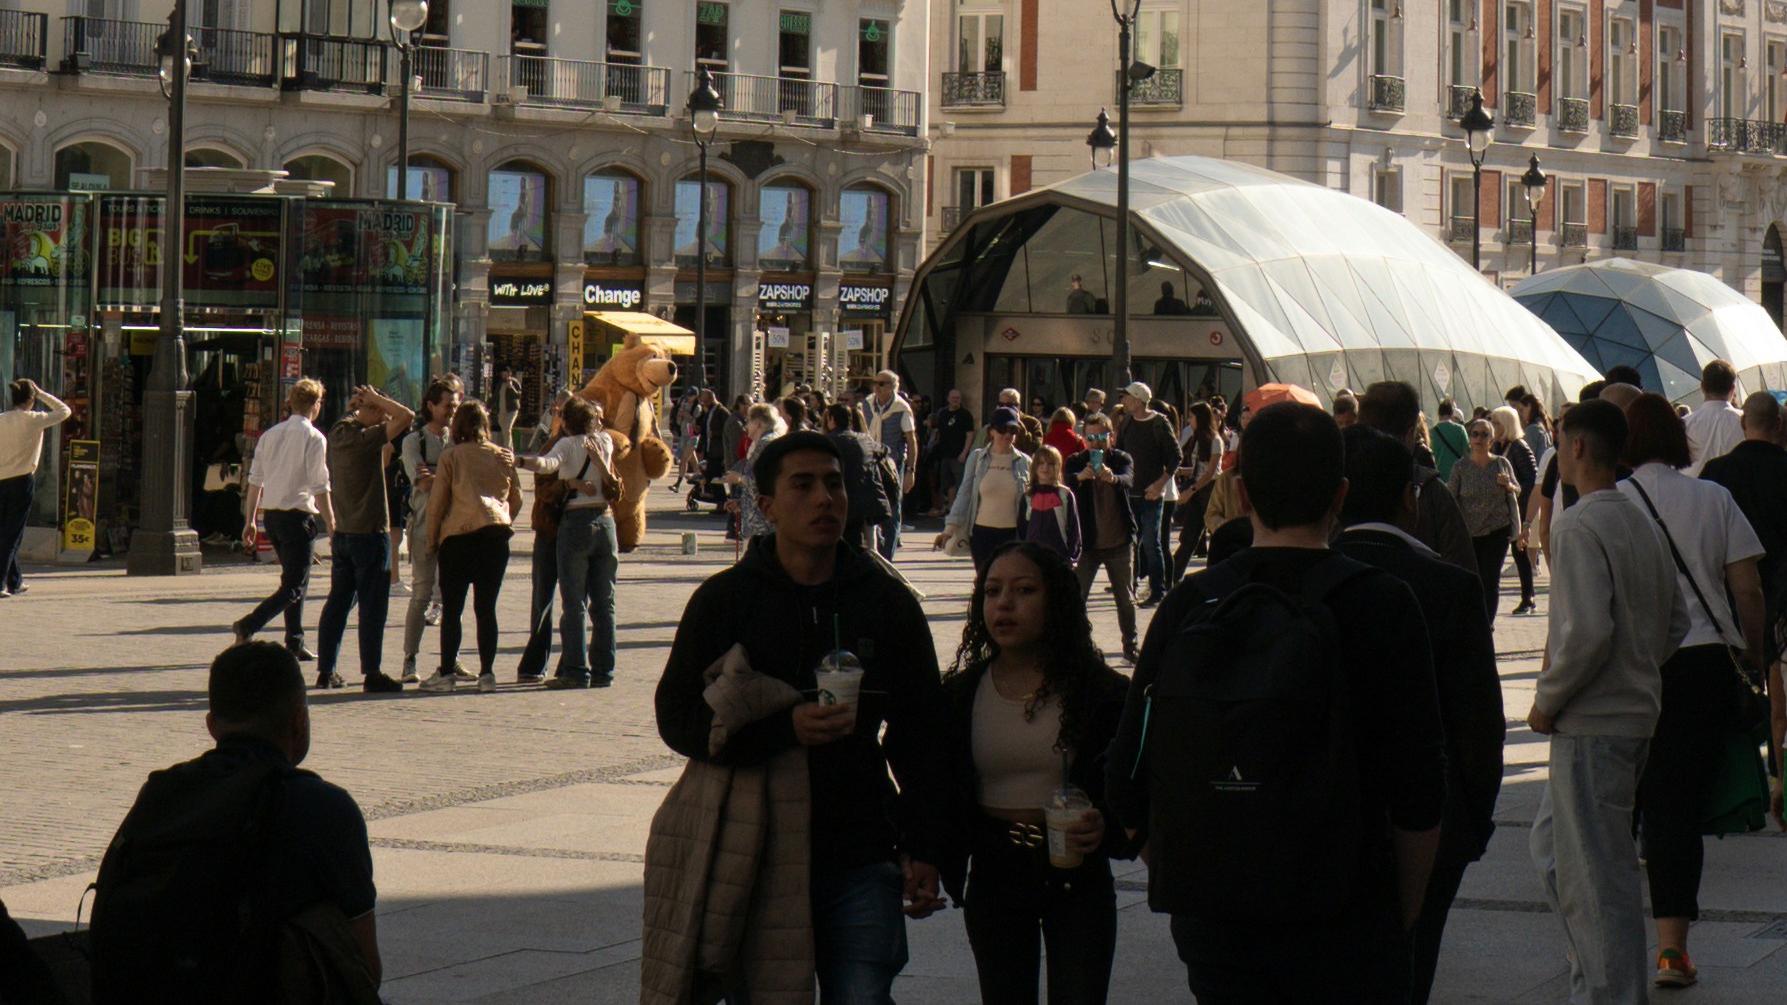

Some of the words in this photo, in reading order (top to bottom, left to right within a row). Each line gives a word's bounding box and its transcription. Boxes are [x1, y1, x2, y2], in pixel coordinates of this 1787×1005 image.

[3, 203, 62, 222] MADRID
[189, 206, 221, 215] DRINKS
[357, 211, 415, 231] MADRID
[107, 227, 141, 247] BIG
[584, 284, 641, 308] Change
[759, 284, 810, 300] ZAPSHOP
[840, 286, 888, 302] ZAPSHOP
[571, 325, 581, 386] CHAN
